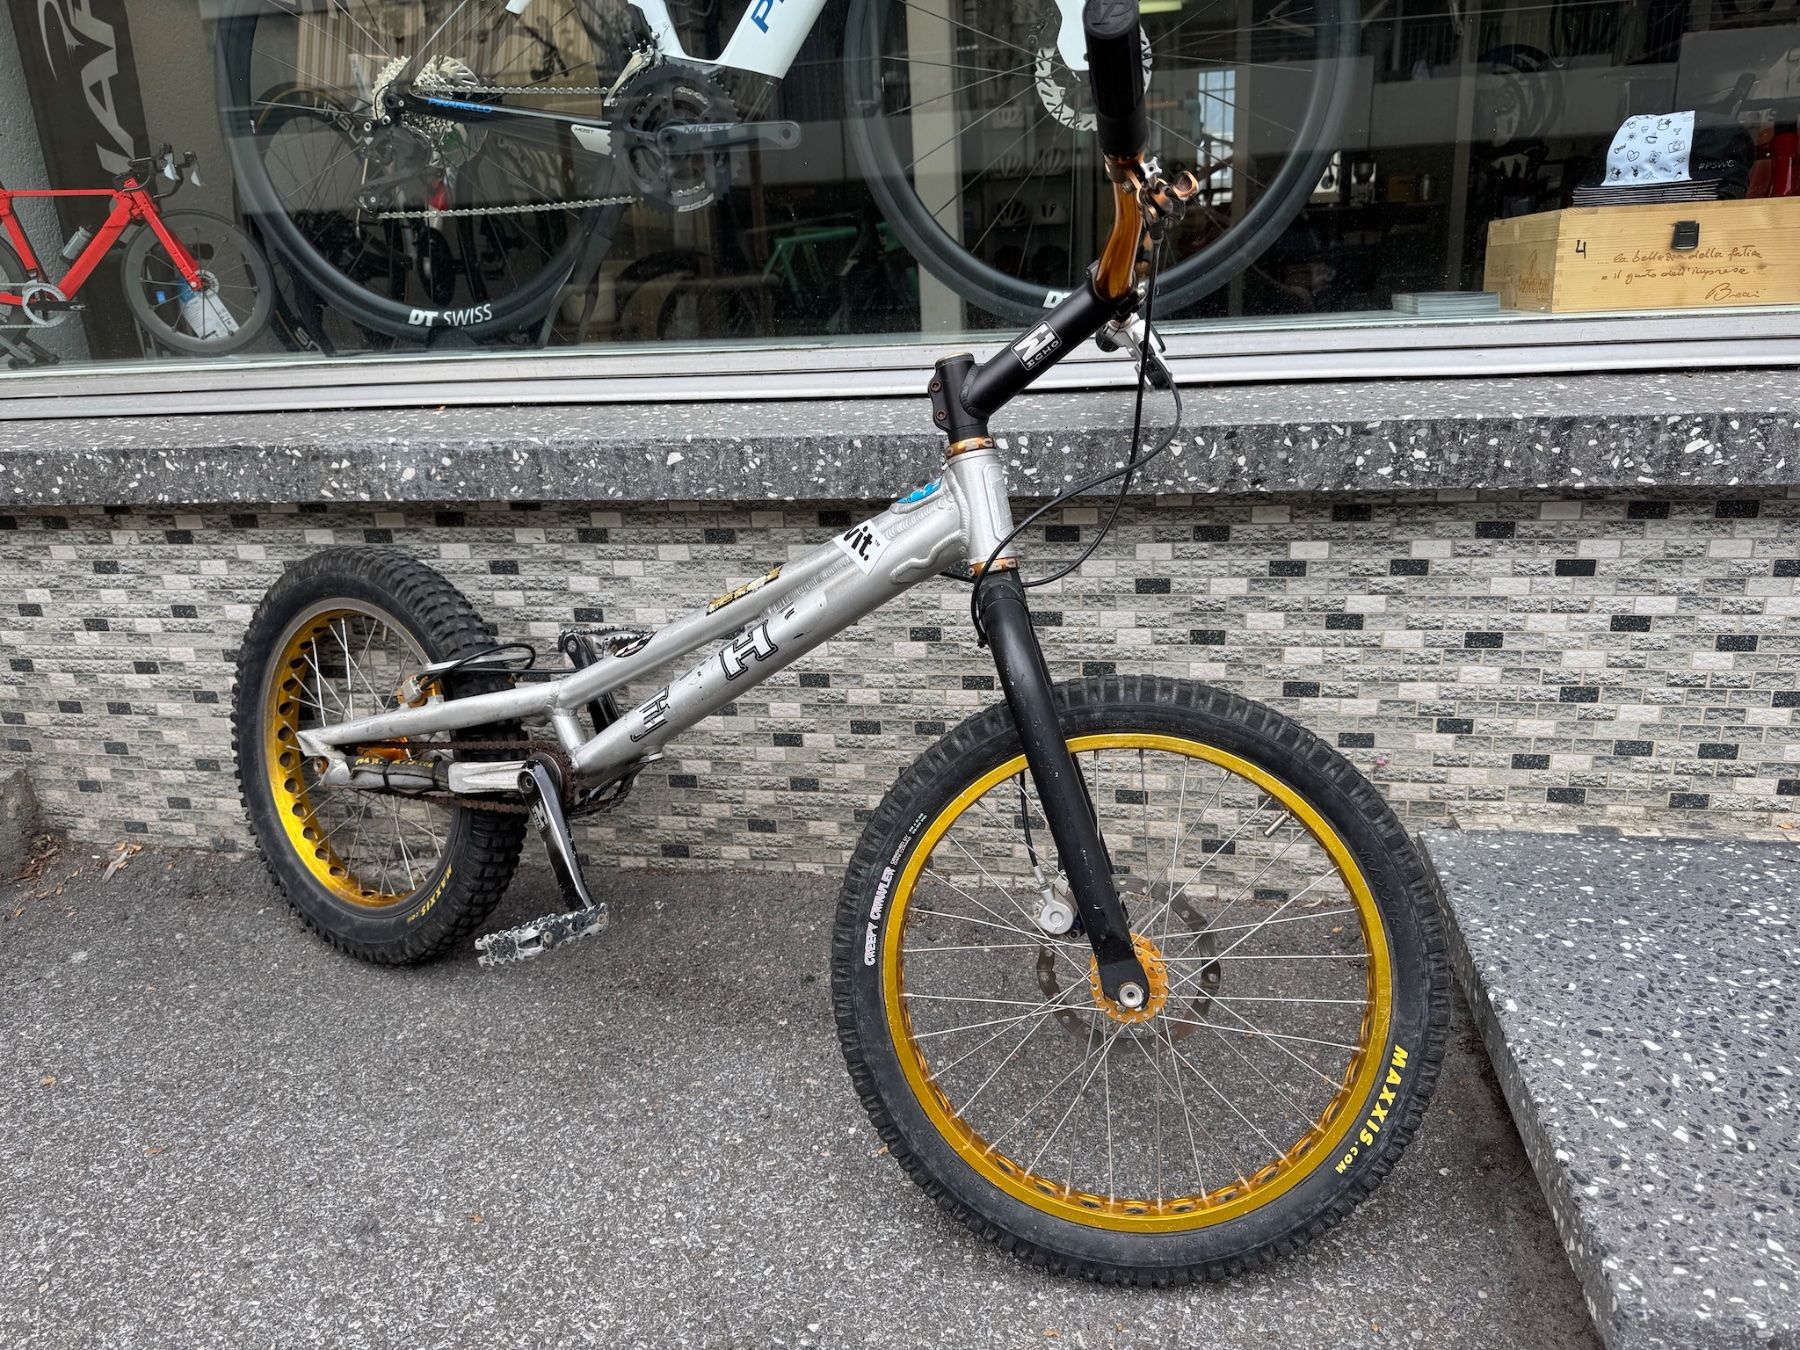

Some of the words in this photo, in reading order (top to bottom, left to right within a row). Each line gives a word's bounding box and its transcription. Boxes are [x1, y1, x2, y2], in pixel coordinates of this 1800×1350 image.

[1575, 239, 1587, 259] 4
[408, 308, 439, 327] DT
[443, 303, 493, 327] SWISS
[869, 866, 896, 921] CRAWLER
[864, 921, 879, 967] CREEPY
